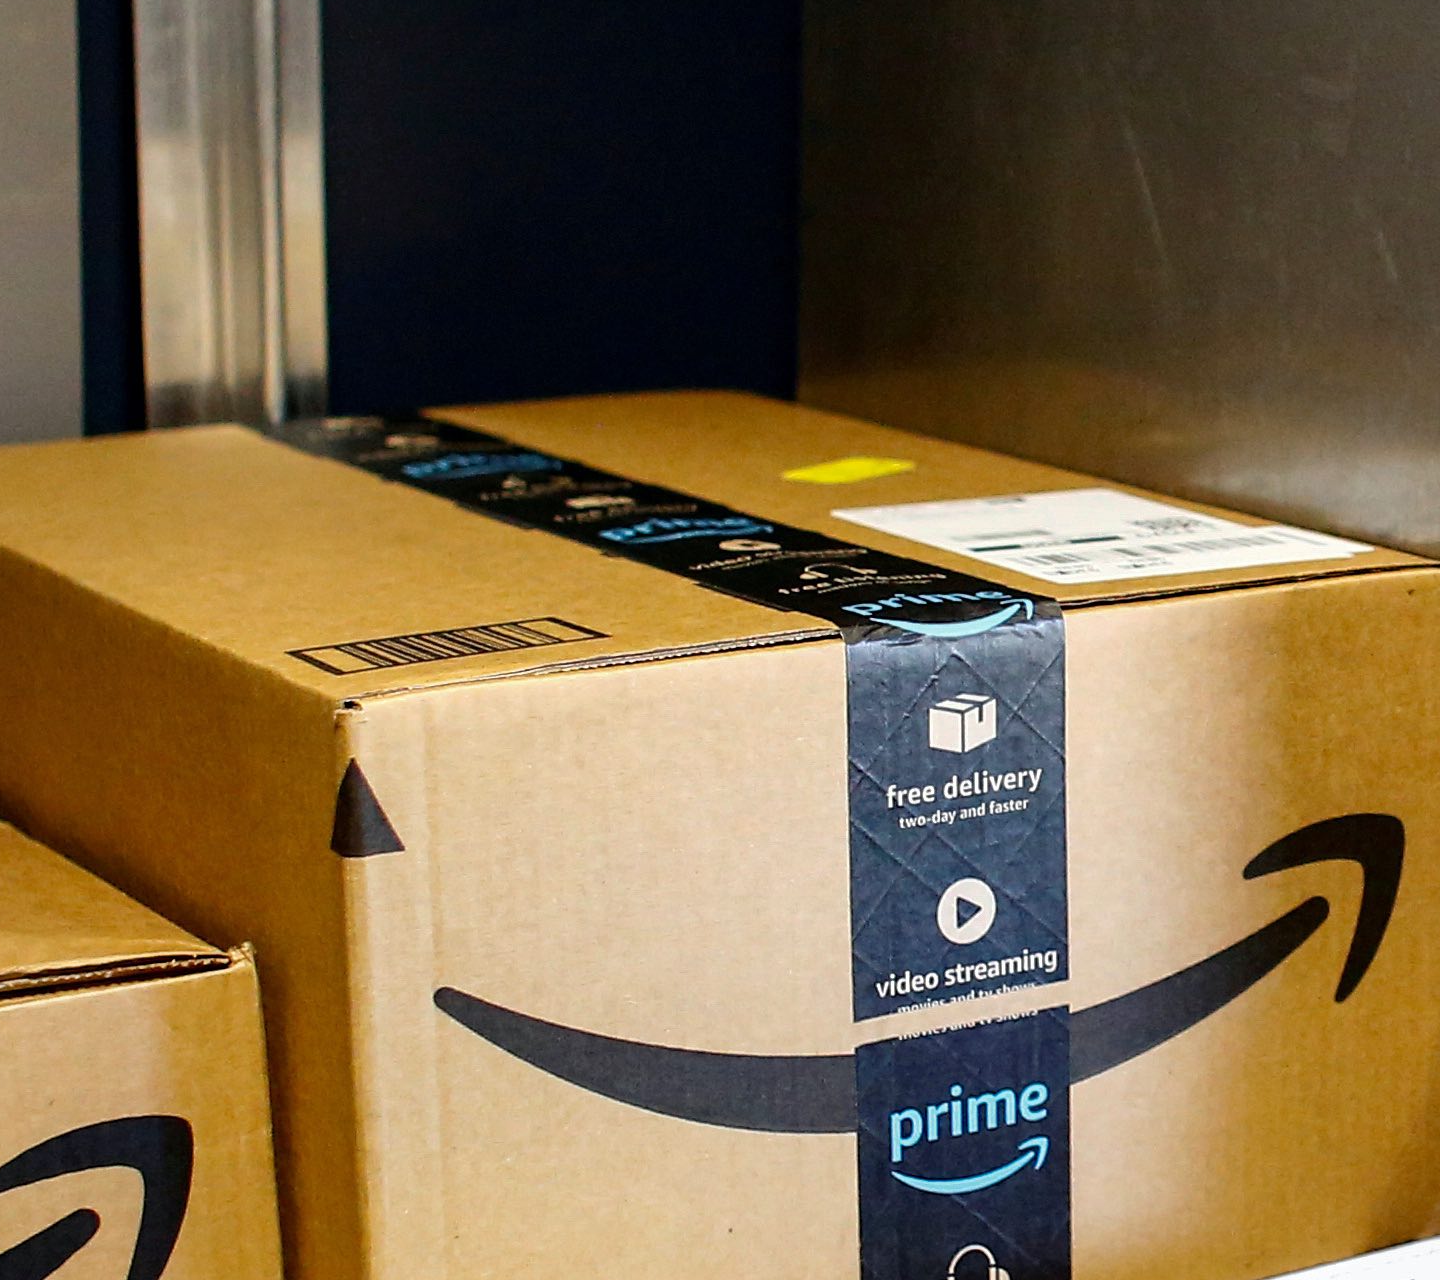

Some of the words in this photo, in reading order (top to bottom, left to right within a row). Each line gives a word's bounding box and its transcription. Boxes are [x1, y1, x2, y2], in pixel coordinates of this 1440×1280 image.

[842, 589, 1014, 617] prime
[885, 784, 936, 809] free
[942, 768, 1044, 800] delivery
[898, 809, 957, 830] two-day
[960, 802, 986, 820] and
[988, 798, 1030, 815] faster
[876, 970, 939, 999] video
[944, 948, 1059, 987] streaming
[889, 1082, 1050, 1163] prime
